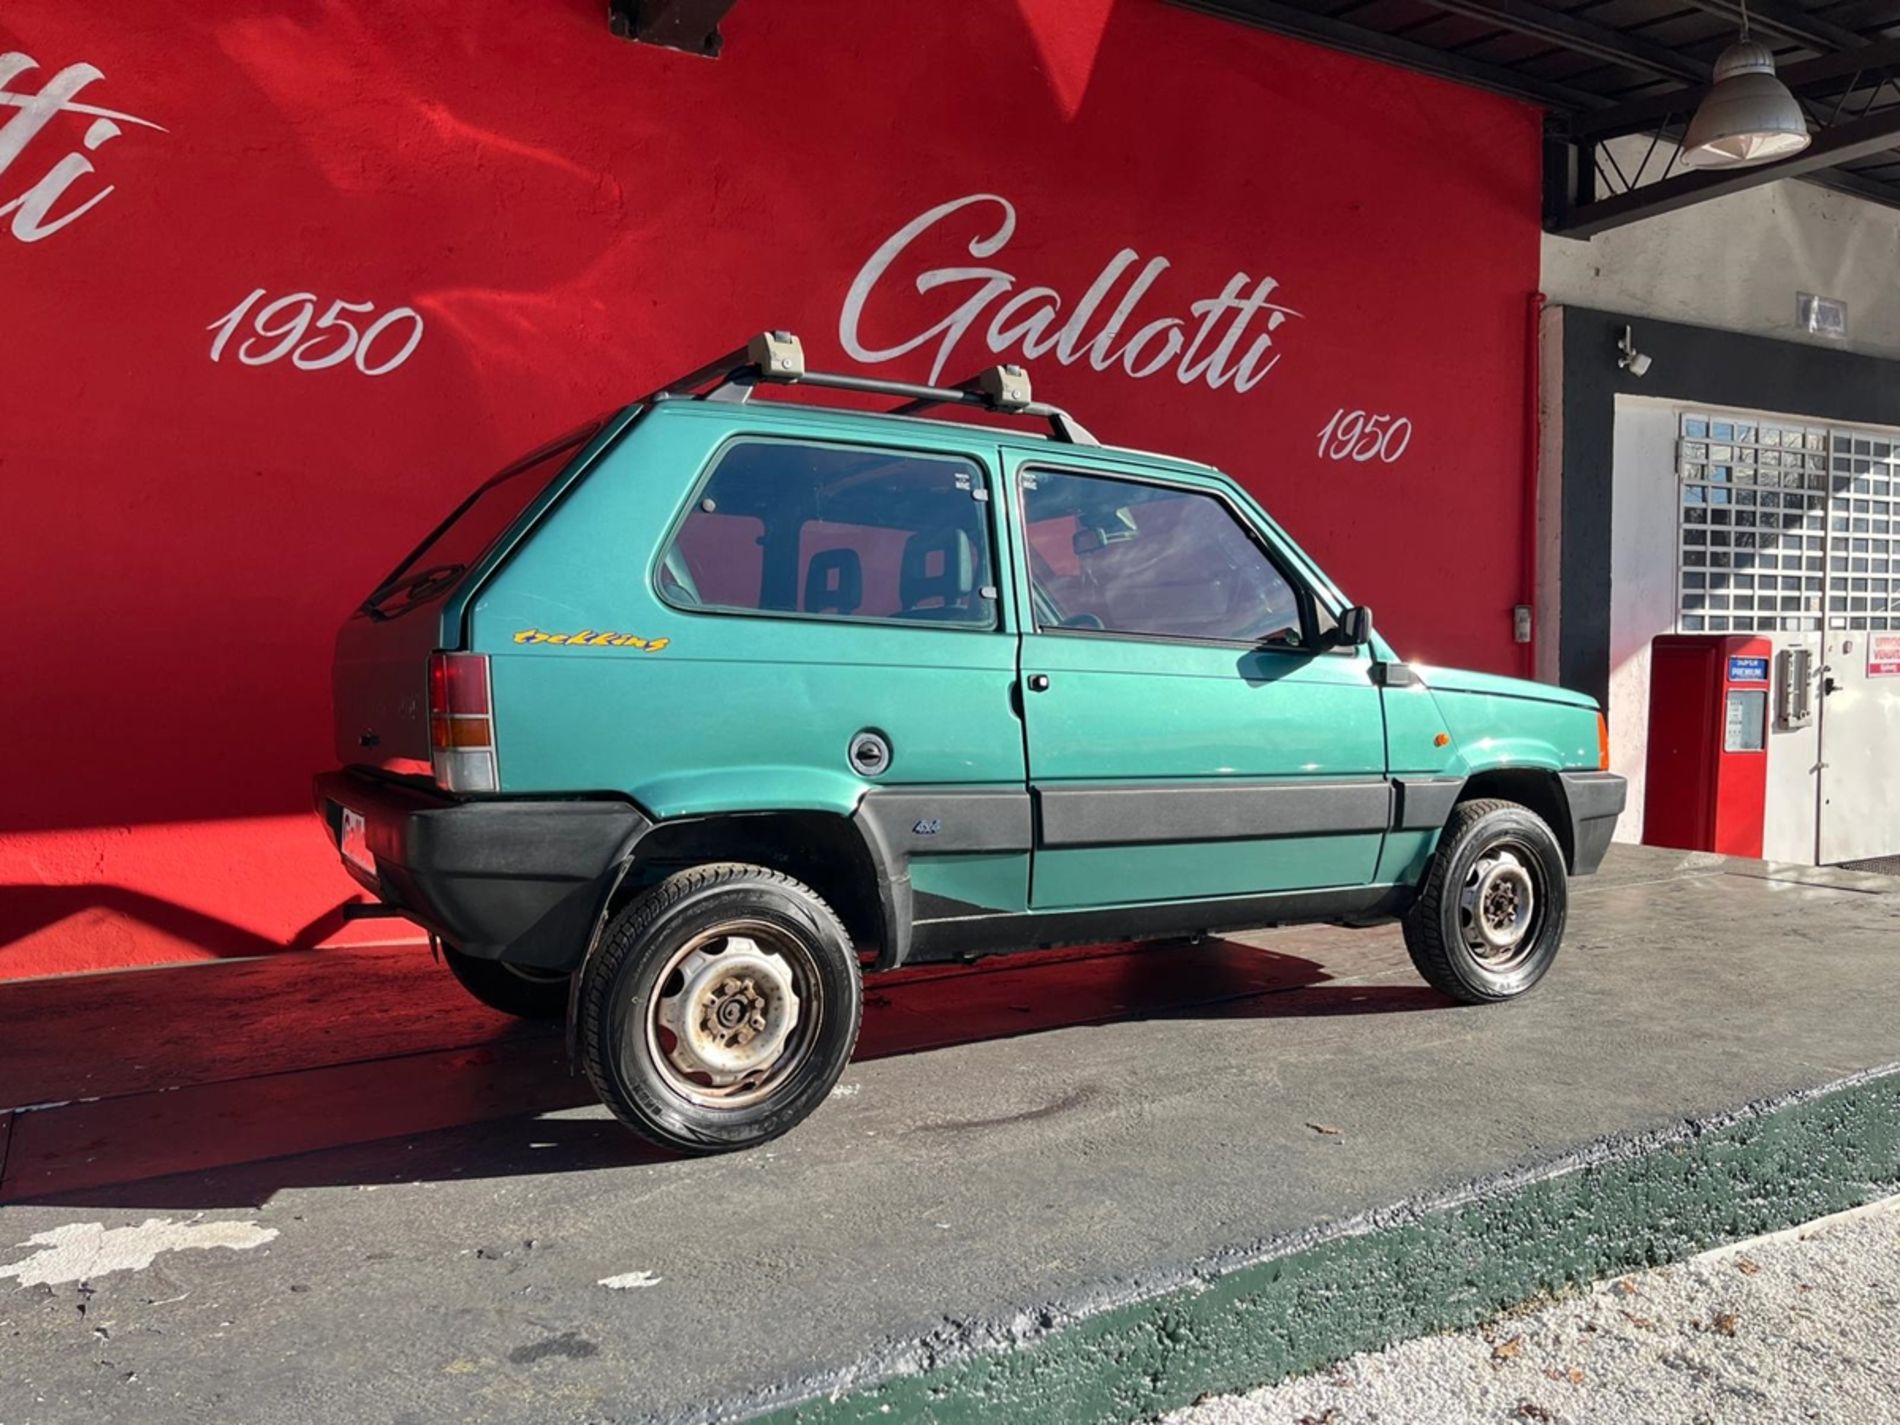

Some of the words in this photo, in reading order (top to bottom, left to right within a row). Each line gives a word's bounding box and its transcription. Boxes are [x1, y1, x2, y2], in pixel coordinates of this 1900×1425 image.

[839, 193, 1305, 394] Gallotti
[206, 288, 424, 375] 1950
[1316, 408, 1413, 463] 1950
[513, 628, 671, 653] trekking
